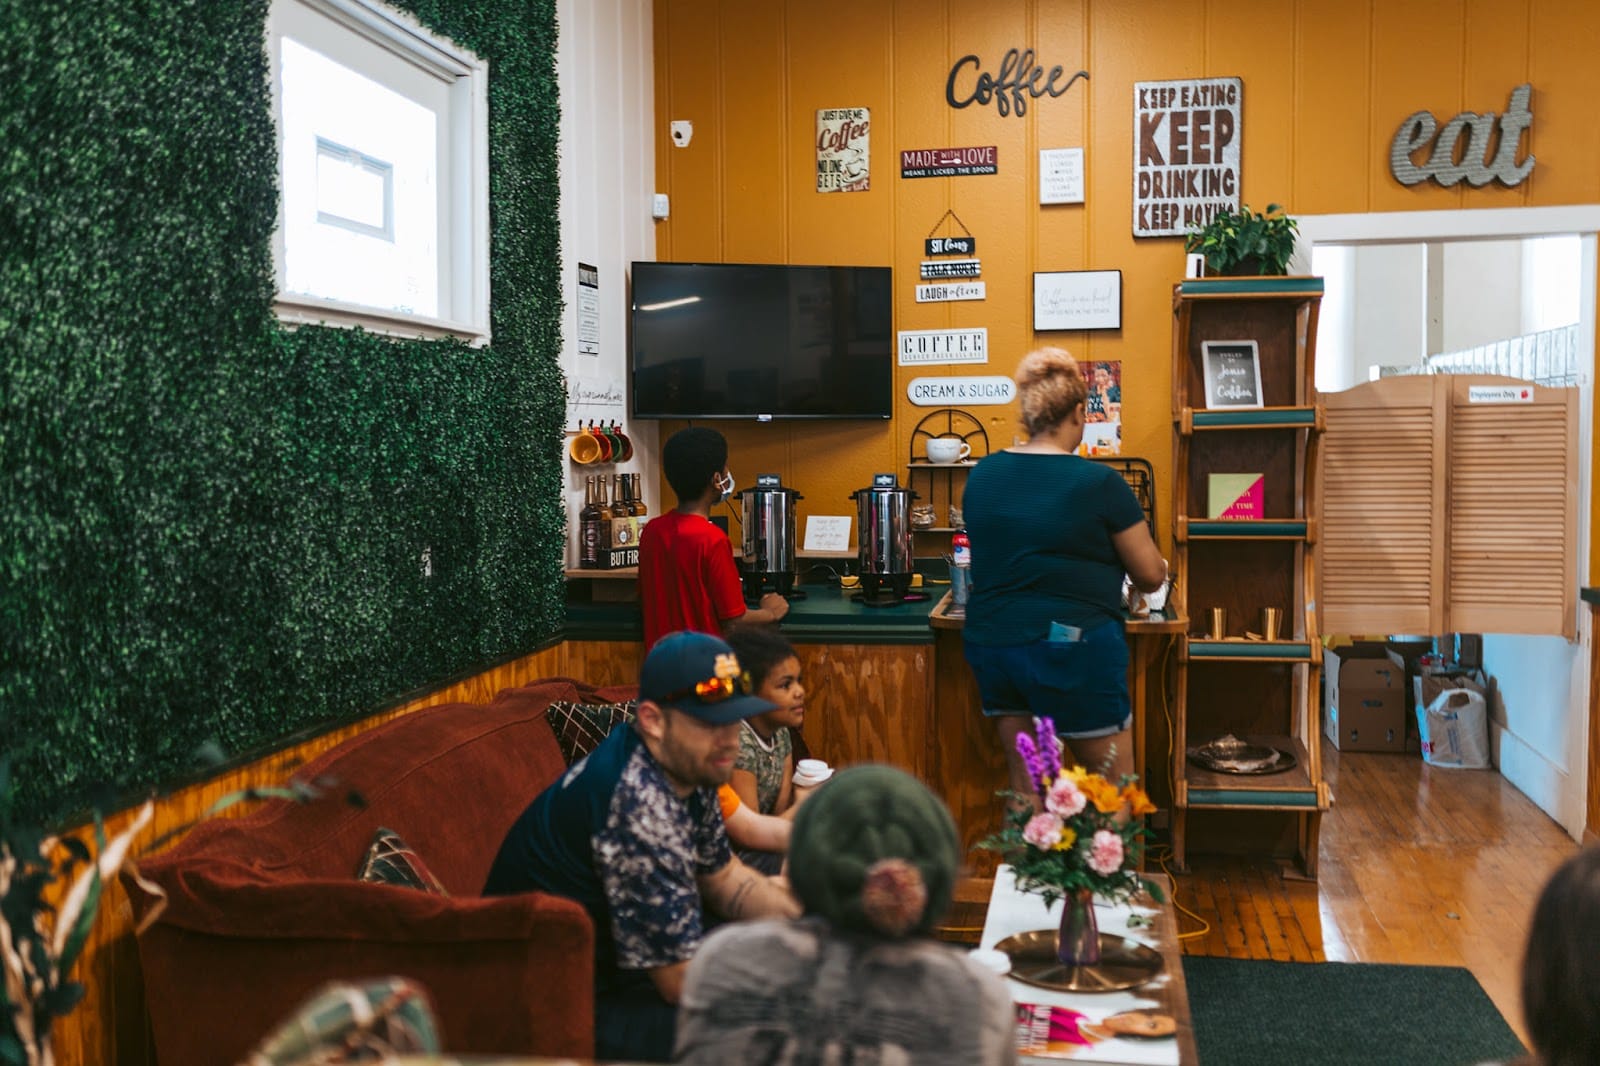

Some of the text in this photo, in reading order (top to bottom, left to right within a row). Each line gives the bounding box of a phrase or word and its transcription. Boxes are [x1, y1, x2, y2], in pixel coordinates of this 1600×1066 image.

[946, 48, 1089, 117] Coffee
[1140, 85, 1236, 109] KEEP EATING
[822, 109, 863, 120] JUST GIVE ME
[817, 120, 870, 152] Coffee
[1140, 109, 1234, 166] KEEP
[1390, 83, 1535, 187] eat
[818, 160, 843, 173] NO ONE
[904, 147, 993, 167] MADE WITH LOVE
[818, 174, 841, 188] GETS
[1139, 168, 1234, 199] DRINKING
[1139, 203, 1179, 230] KEEP
[931, 239, 944, 253] SIT
[920, 287, 948, 300] LAUGH
[904, 335, 981, 353] COFFEE
[915, 383, 1009, 398] CREAM & SUGAR
[610, 551, 625, 567] BUT
